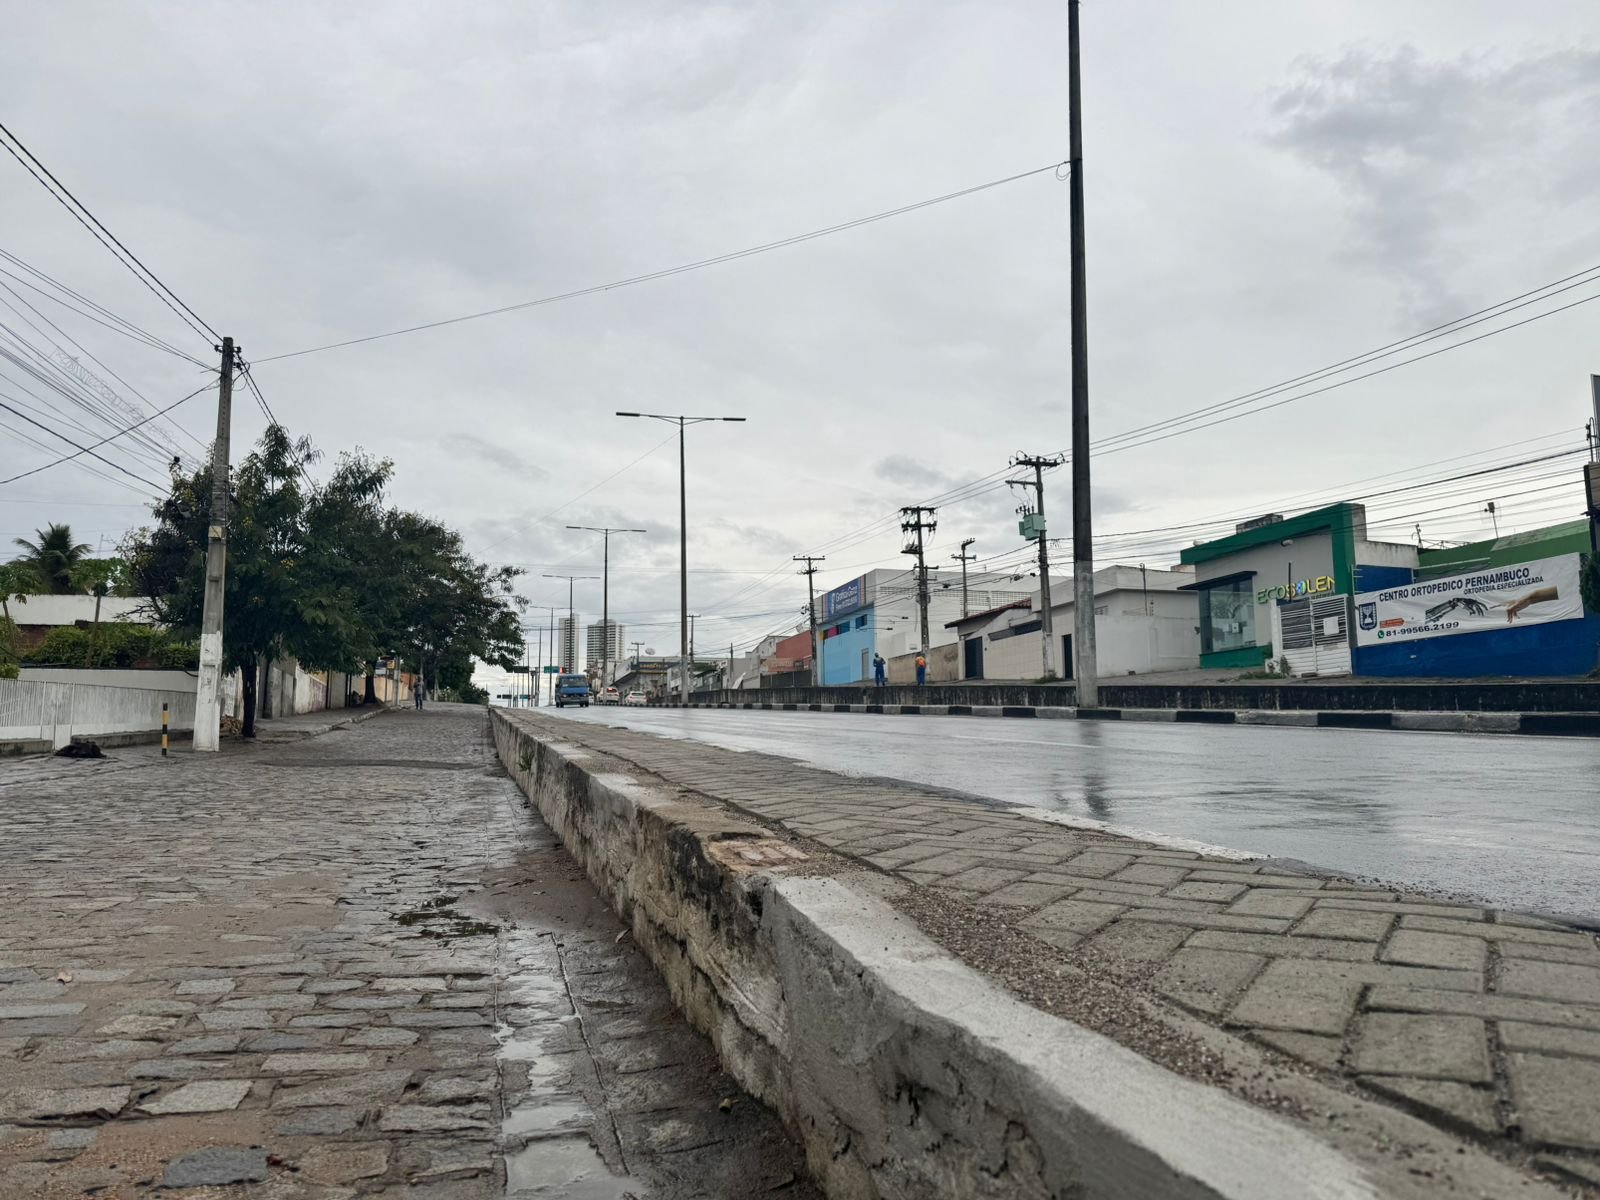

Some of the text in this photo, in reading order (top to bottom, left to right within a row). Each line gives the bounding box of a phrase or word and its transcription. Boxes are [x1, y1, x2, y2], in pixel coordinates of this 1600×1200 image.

[1379, 567, 1530, 602] CENTRO ORTOPEDICO PERNAMBUCO
[1463, 576, 1544, 595] ORTOPEDIA ESPECIALIZADA
[1385, 621, 1460, 637] 81-99566.2199
